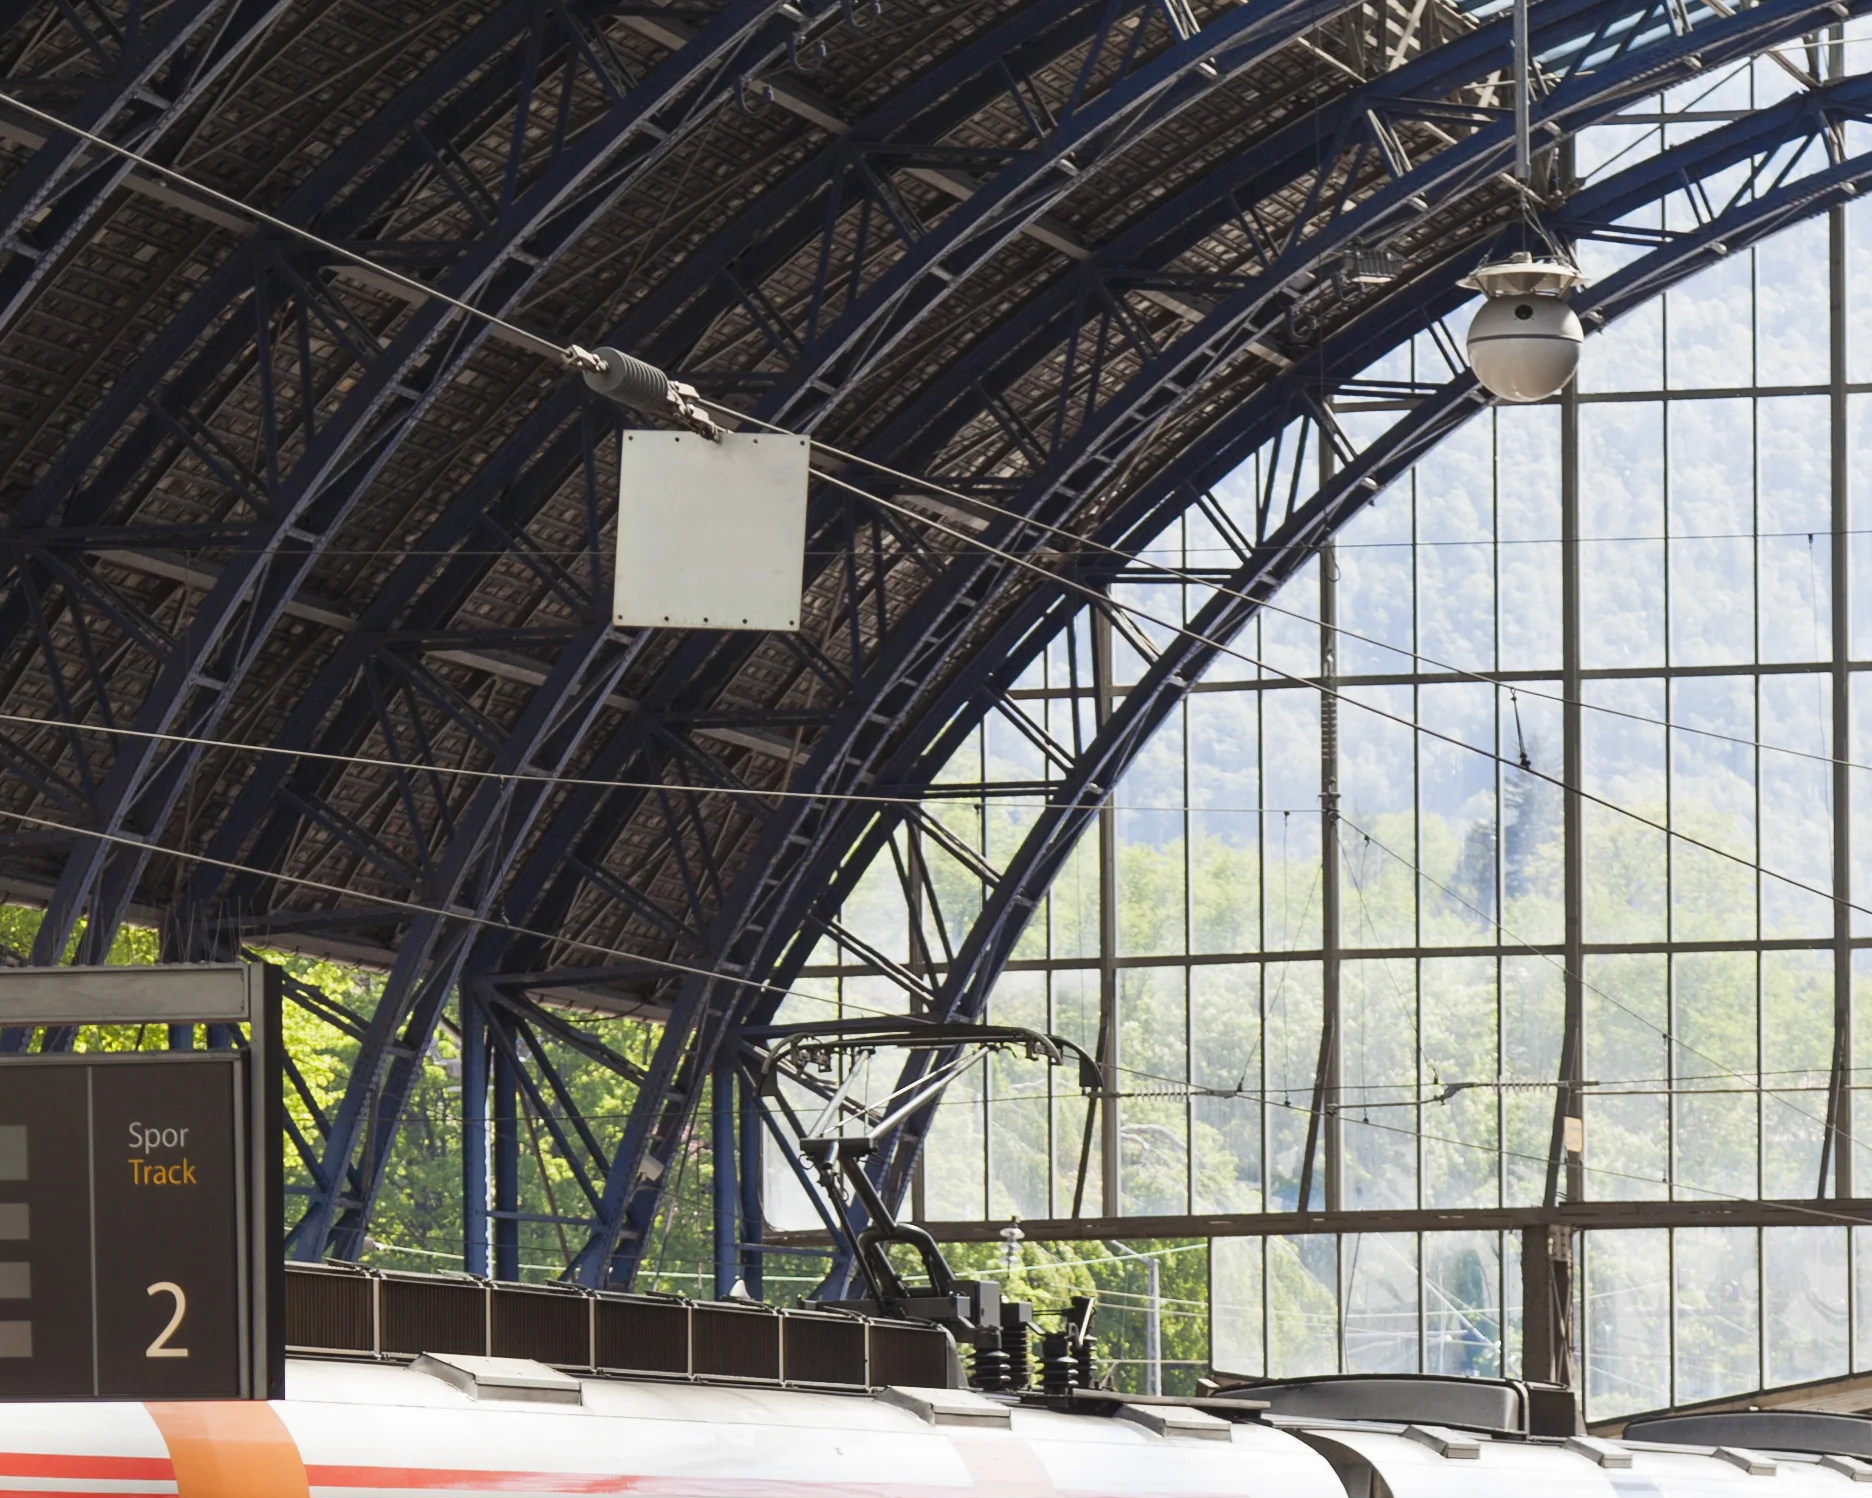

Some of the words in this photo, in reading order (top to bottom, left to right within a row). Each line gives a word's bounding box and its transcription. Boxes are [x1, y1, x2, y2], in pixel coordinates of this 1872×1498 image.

[128, 1121, 189, 1154] Spor
[128, 1157, 197, 1185] Track
[145, 1281, 189, 1357] 2
